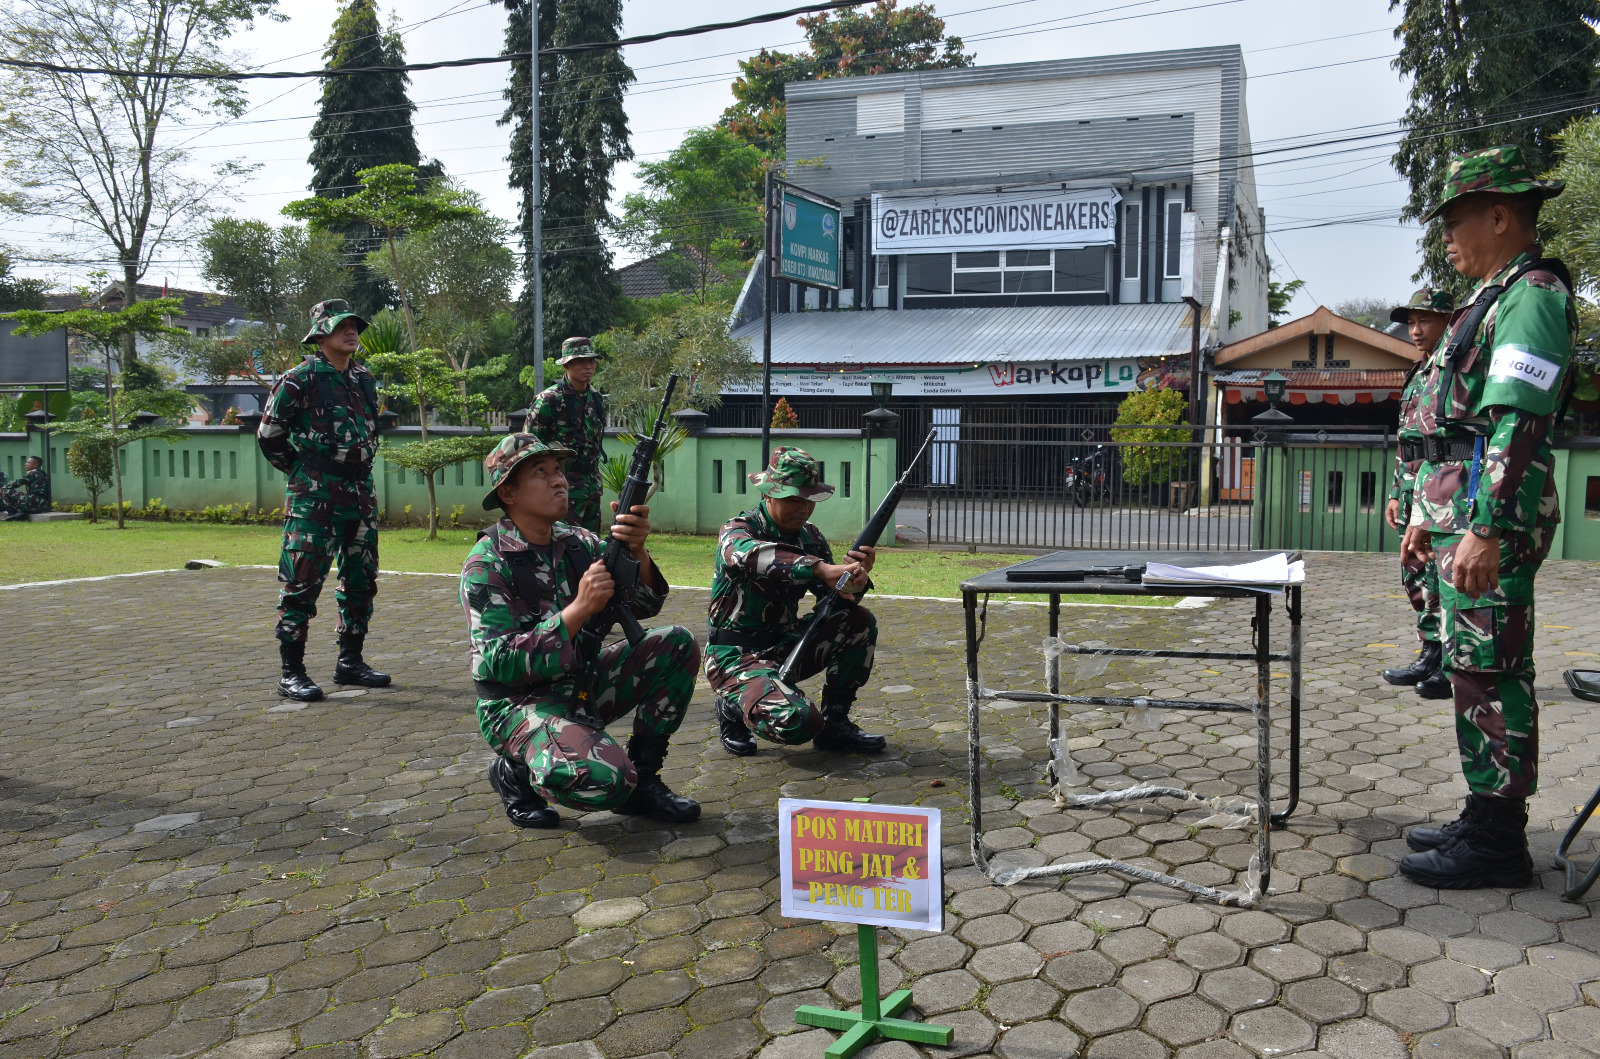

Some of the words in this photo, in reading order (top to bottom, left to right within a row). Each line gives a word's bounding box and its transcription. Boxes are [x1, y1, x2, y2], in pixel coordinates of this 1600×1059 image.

[881, 201, 1109, 239] @ZAREKSECONDSNEAKERS
[790, 242, 807, 259] KOMPI
[807, 247, 829, 264] MARKAS
[796, 815, 837, 840] POS
[844, 818, 923, 847] MATERI
[799, 848, 853, 875] PENG
[860, 853, 895, 879] JAT
[902, 857, 921, 880] &
[808, 881, 864, 909] PENG
[871, 887, 912, 913] TER
